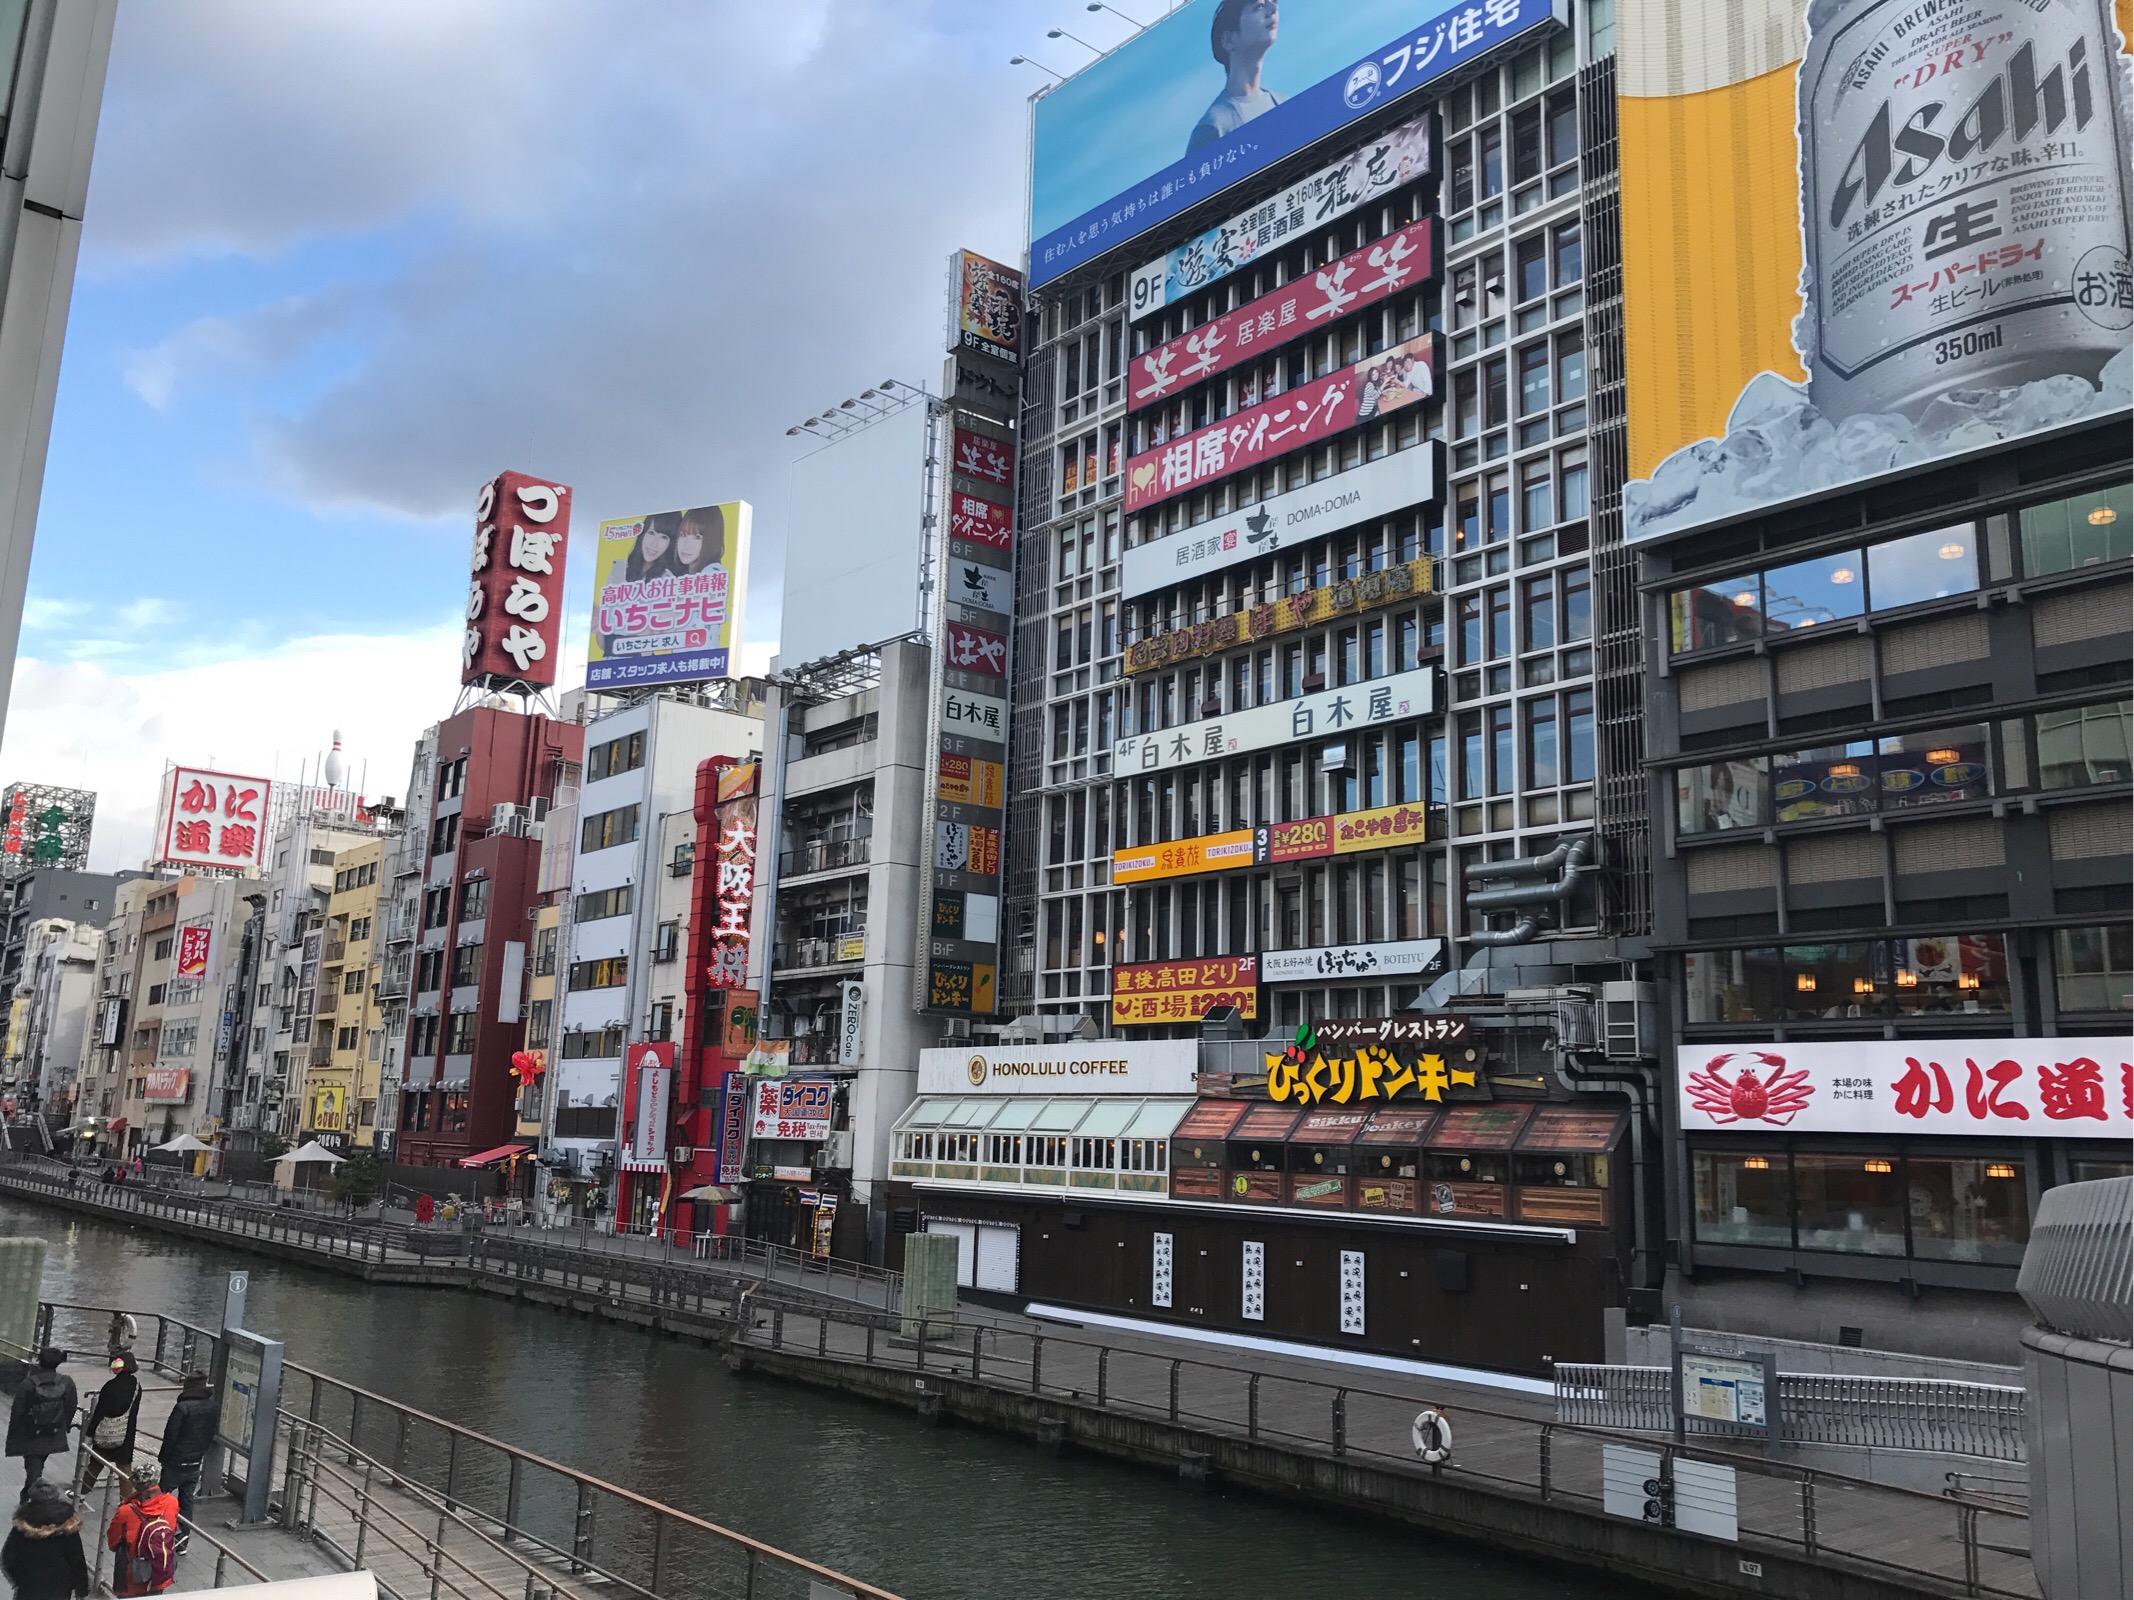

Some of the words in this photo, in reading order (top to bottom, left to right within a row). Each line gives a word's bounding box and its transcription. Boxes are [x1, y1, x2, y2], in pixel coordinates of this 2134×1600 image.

[1911, 24, 1948, 47] DRAFT
[1951, 10, 1982, 28] BEER
[1928, 6, 1964, 28] ASAHI
[1382, 0, 1521, 88] フジ住宅
[1908, 43, 1930, 58] BEER
[1931, 35, 1948, 48] FOR
[1924, 33, 1972, 62] SUPER
[1852, 41, 1890, 90] ASAHI
[1830, 33, 2095, 230] Asahi
[1044, 143, 1259, 264] 住む人を思う気持ちは誰にも負けない。
[1848, 141, 2085, 243] 洗練されたクリアな味、辛口。
[1239, 203, 1277, 236] 全室個室
[1256, 206, 1306, 248] 居酒屋
[1923, 199, 2002, 260] 生
[2052, 214, 2085, 226] SUPER
[1890, 238, 2046, 309] スーパードライ
[1134, 273, 1162, 310] 9F
[1236, 299, 1297, 347] 居楽屋
[964, 331, 980, 349] 9F
[981, 341, 1018, 364] 全室個室
[1935, 325, 2002, 365] 350ml
[1161, 380, 1351, 492] 相席ダイニング
[957, 442, 1010, 483] 笑笑
[962, 497, 989, 520] 相席
[1287, 490, 1361, 526] DOMA-DOMA
[952, 515, 1012, 546] ダイニング
[1176, 533, 1221, 567] 居酒家
[502, 485, 566, 670] づぼらや
[602, 572, 727, 605] 高収入お仕事情報
[600, 593, 726, 634] いちごナビ
[961, 608, 977, 622] 5F
[616, 637, 659, 652] いちごナビ
[661, 635, 680, 648] 求人
[949, 630, 1005, 673] はや
[946, 694, 1001, 729] 白木屋
[1292, 685, 1394, 738] 白木屋
[1119, 740, 1136, 757] 4F
[1142, 724, 1224, 770] 白木屋
[180, 779, 259, 822] かに
[1114, 859, 1151, 872] TORIKIZOKU
[1206, 843, 1249, 858] TORIKIZOKU
[709, 820, 757, 986] 大阪王将
[182, 934, 196, 967] ドラッグ
[193, 930, 208, 961] ツルハ
[933, 942, 954, 956] B1F
[1384, 953, 1424, 965] BOTEJYU
[1429, 961, 1441, 971] 2F
[935, 972, 968, 989] びっくり
[1114, 962, 1238, 992] 豊後高田どり
[1239, 957, 1255, 971] 2F
[931, 988, 969, 1007] ドンキー
[1134, 995, 1188, 1018] 酒場
[846, 1003, 858, 1034] ZERO
[1316, 1019, 1466, 1041] ハンバーグレストラン
[993, 1061, 1066, 1077] HONOLULU
[1069, 1059, 1129, 1075] COFFEE
[1265, 1044, 1476, 1104] びっくりドンキー
[1832, 1077, 1873, 1089] 本場の味
[760, 1083, 778, 1115] 薬
[782, 1086, 829, 1107] ダイコク
[1832, 1089, 1874, 1100] かに料理
[1891, 1057, 2133, 1121] かに道
[727, 1095, 744, 1140] ダイコク
[777, 1121, 807, 1138] 免税
[721, 1166, 740, 1176] 免税
